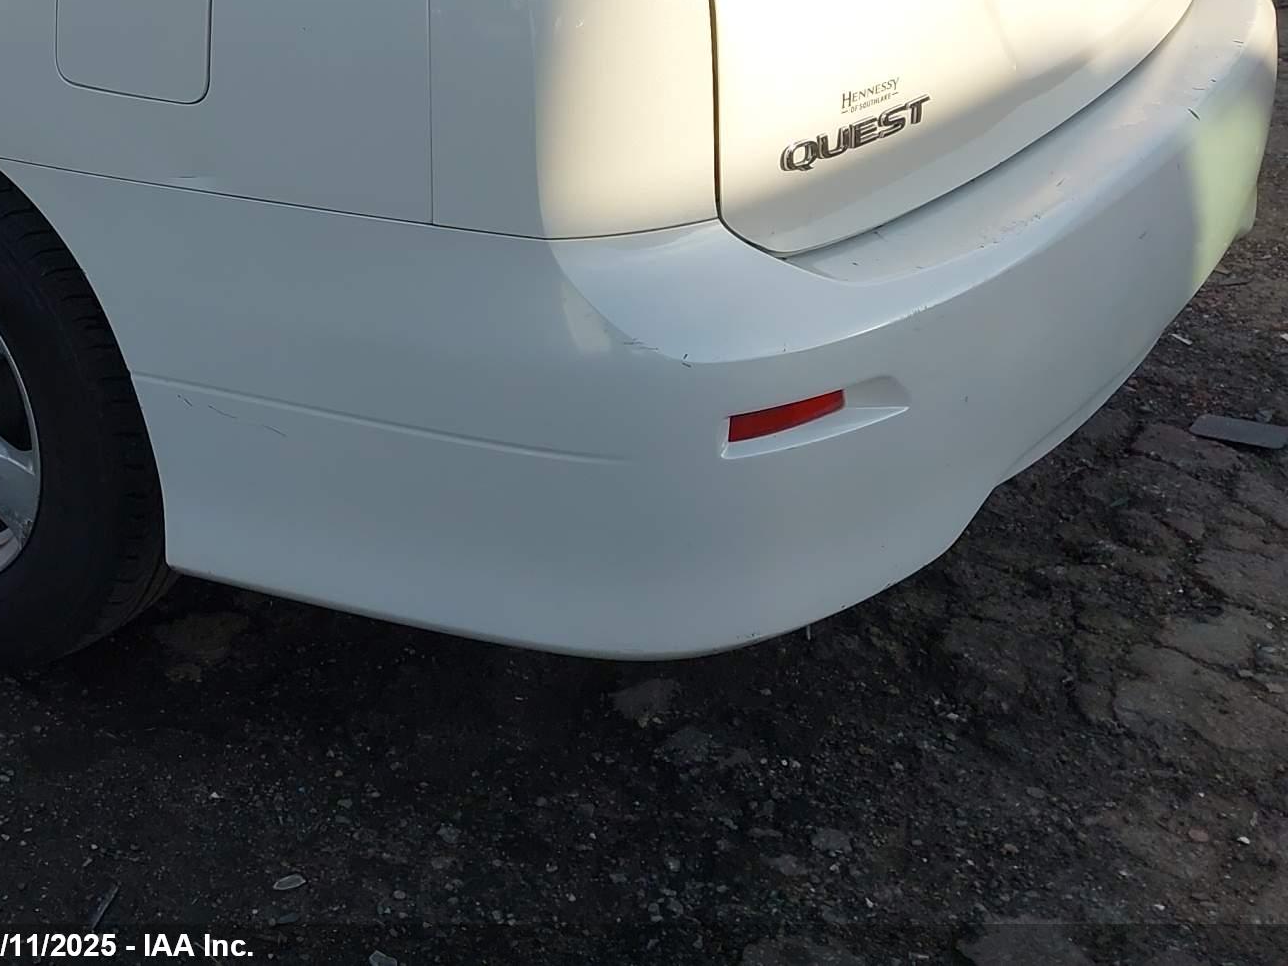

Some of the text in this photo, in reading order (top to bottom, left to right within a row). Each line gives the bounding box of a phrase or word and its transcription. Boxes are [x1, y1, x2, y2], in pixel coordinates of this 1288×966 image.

[841, 77, 900, 109] HENNESSY
[850, 105, 859, 113] OF
[779, 93, 931, 172] QUEST
